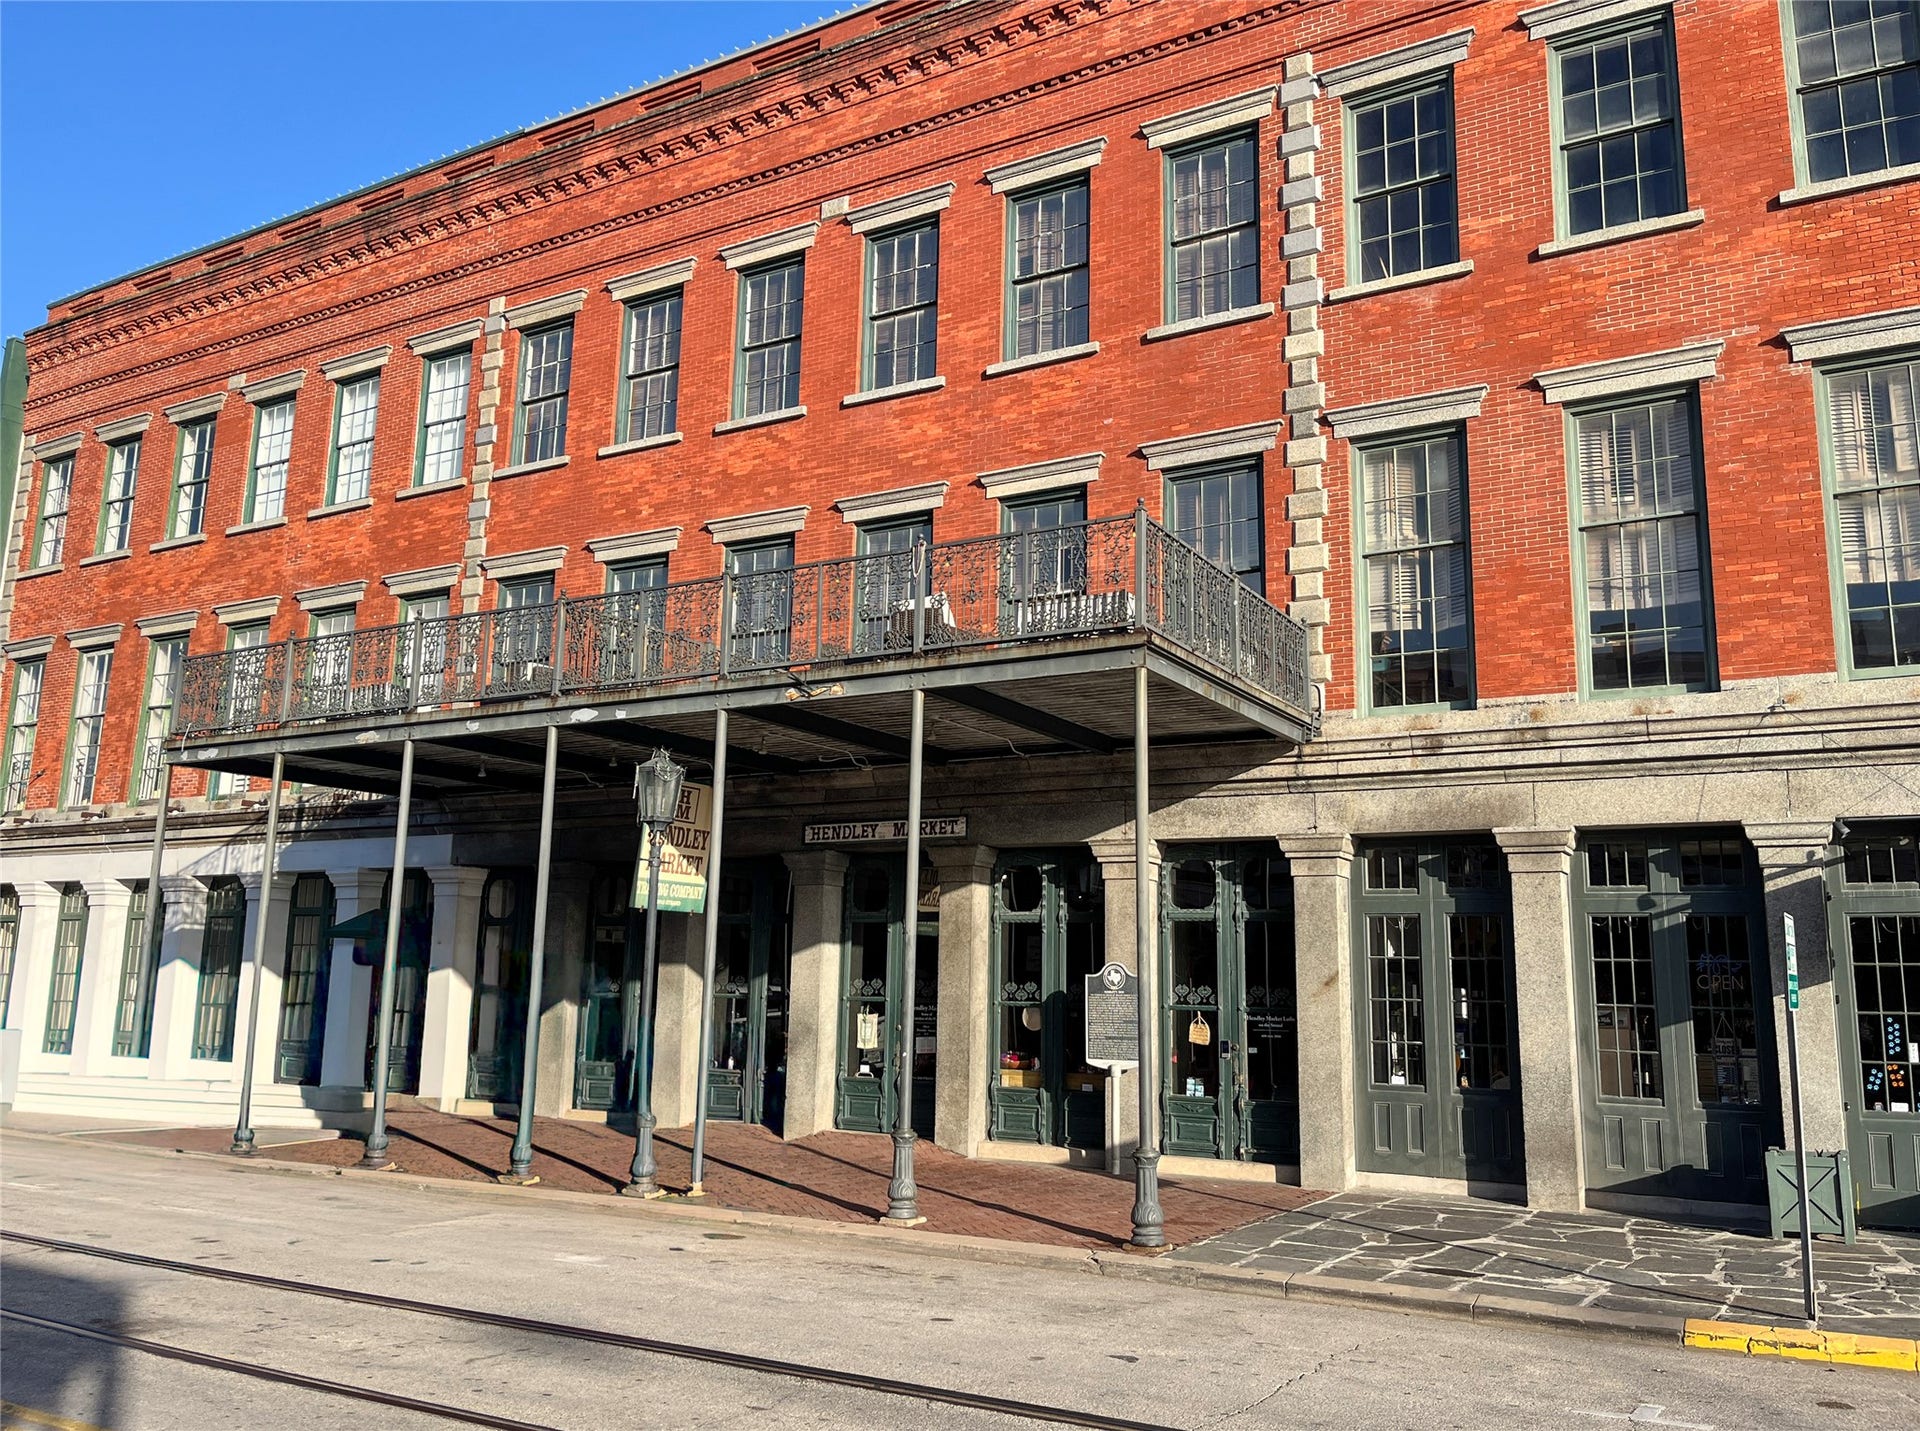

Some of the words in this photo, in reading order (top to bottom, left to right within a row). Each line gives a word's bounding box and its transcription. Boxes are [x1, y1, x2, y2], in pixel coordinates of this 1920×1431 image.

[680, 789, 692, 804] H
[675, 805, 691, 820] M
[810, 824, 879, 841] HENDLEY
[893, 820, 960, 837] MRKET
[646, 851, 704, 877] ARKET
[670, 884, 704, 900] COMPANY
[1697, 975, 1744, 990] OPEN
